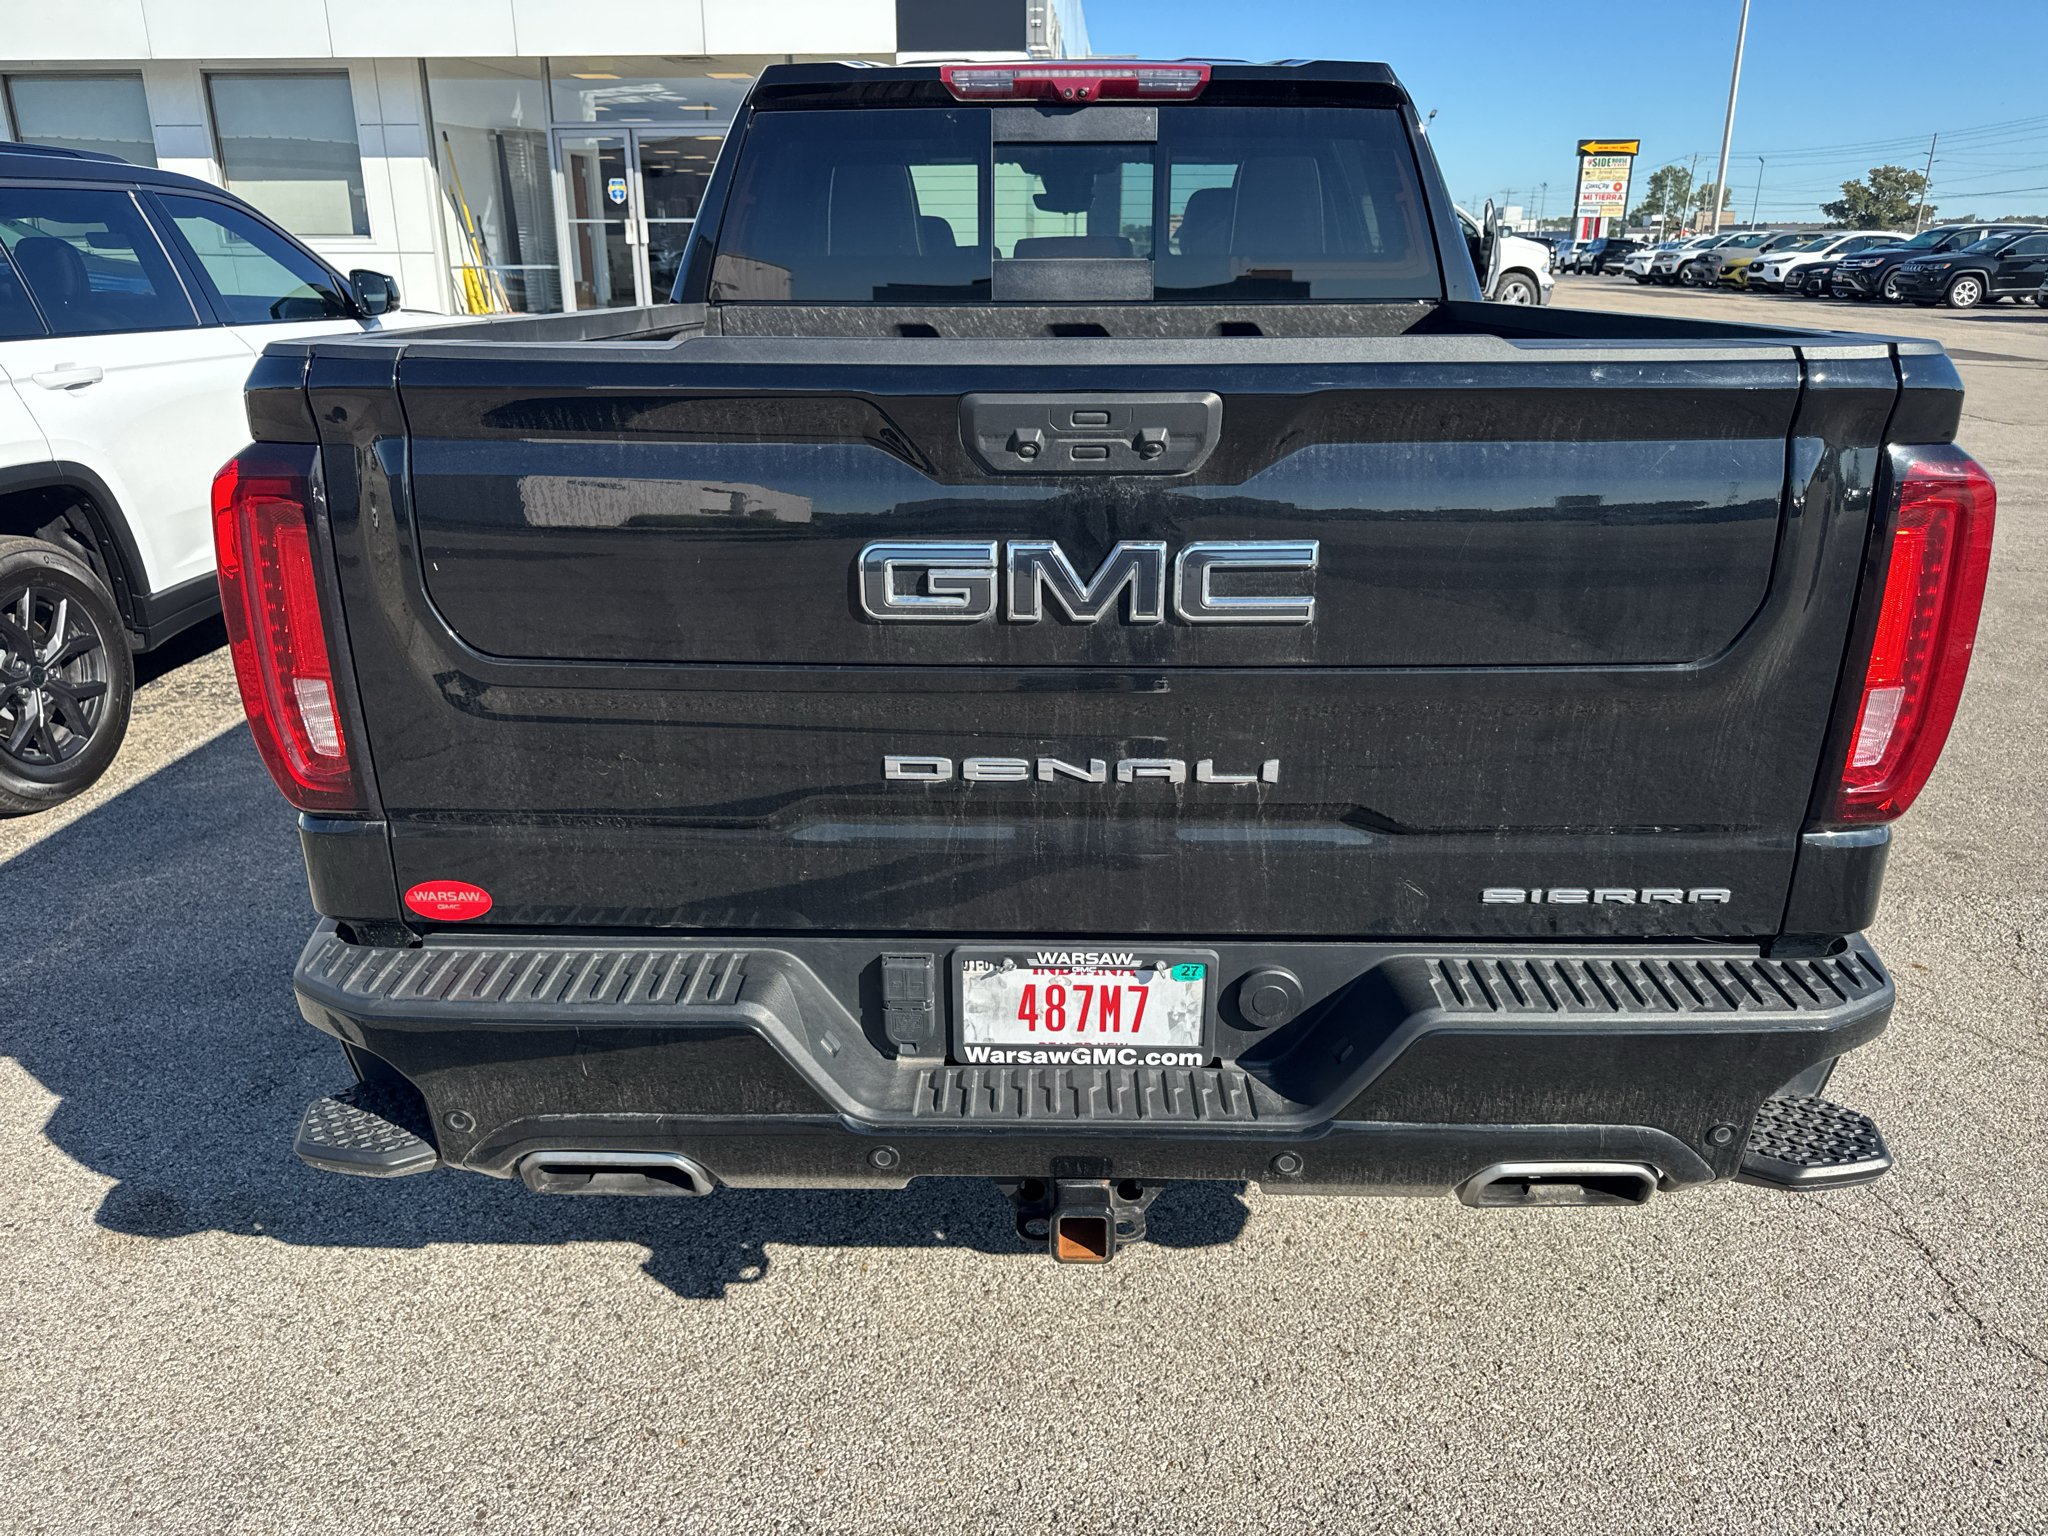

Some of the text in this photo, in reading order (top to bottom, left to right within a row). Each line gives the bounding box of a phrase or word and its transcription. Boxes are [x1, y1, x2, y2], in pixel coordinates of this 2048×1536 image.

[1592, 158, 1611, 167] SIDE
[858, 540, 1320, 623] GMC
[883, 755, 1280, 784] DENALI
[413, 891, 480, 902] WARSAW
[1480, 887, 1732, 904] SIERRA
[1036, 951, 1134, 966] WARSAW
[1181, 965, 1199, 977] 27
[1017, 983, 1149, 1033] 487M7
[963, 1046, 1203, 1067] WarsawGMC.com
